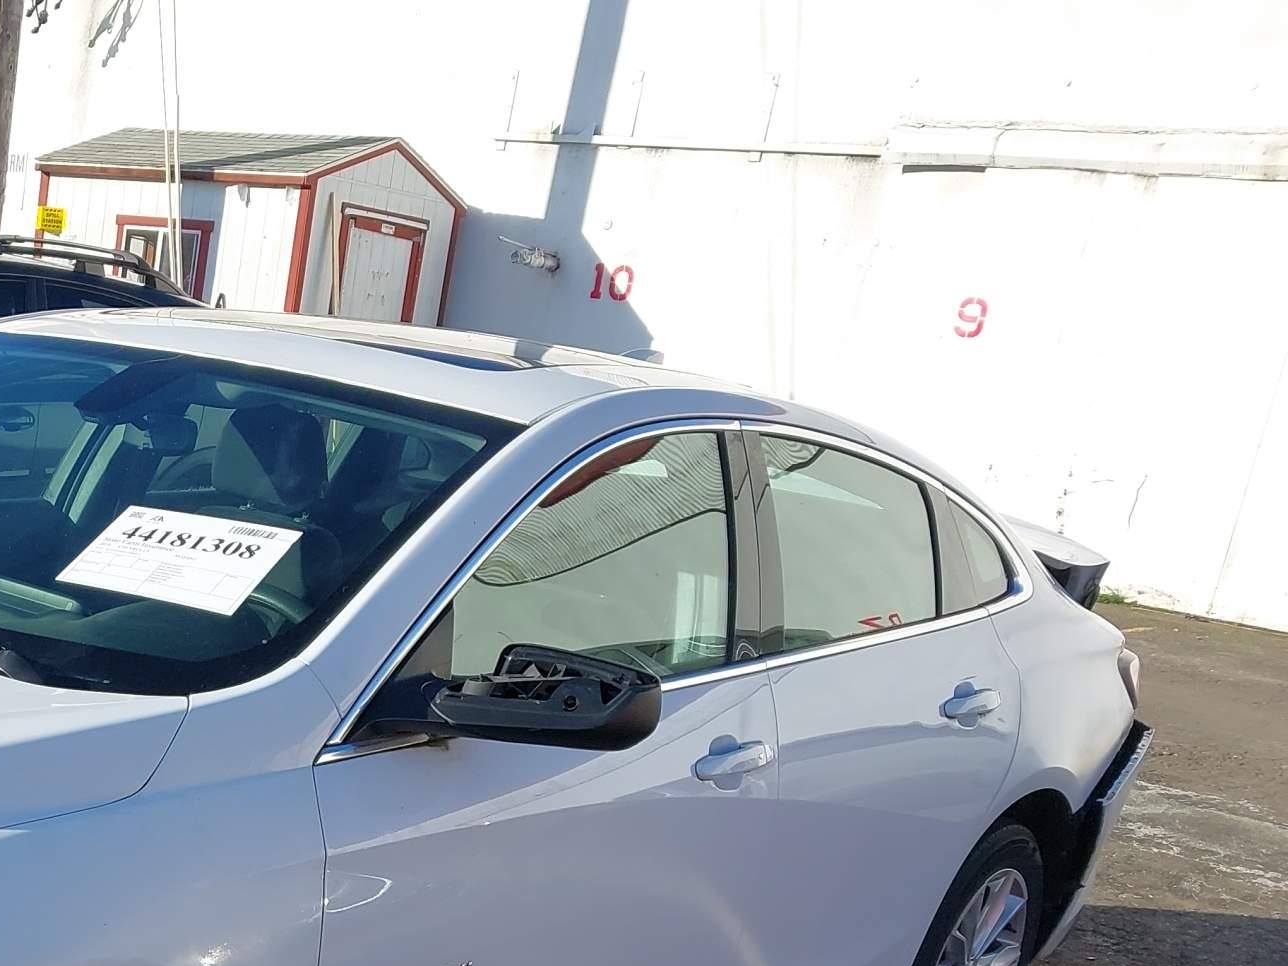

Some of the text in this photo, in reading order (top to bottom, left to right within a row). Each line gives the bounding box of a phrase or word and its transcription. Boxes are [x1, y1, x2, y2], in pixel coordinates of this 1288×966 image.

[589, 262, 634, 301] 10
[954, 297, 988, 338] 9
[122, 525, 261, 560] 44181308
